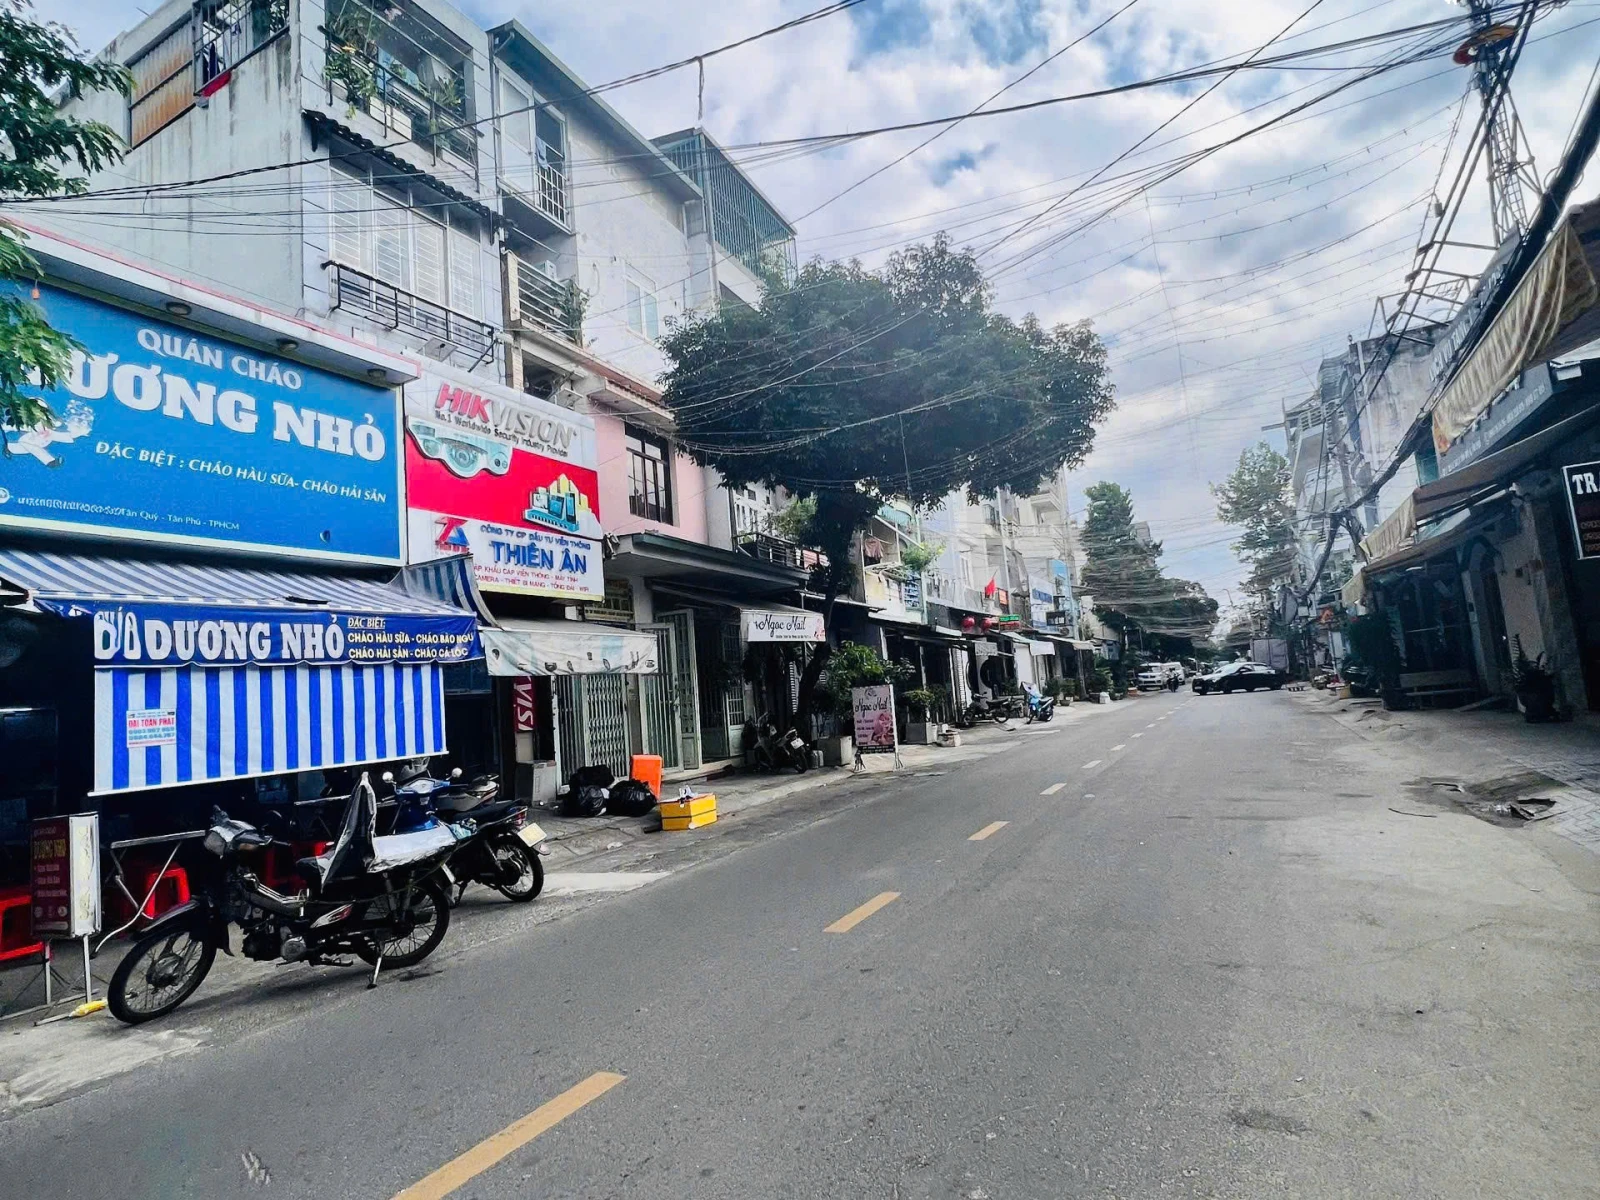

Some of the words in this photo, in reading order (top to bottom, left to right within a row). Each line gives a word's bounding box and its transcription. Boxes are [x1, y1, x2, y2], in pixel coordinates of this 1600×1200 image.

[137, 328, 223, 371] QUÁN
[231, 355, 302, 391] CHÁO
[21, 349, 259, 434] ƯƠNG
[273, 402, 386, 462] NHỎ
[434, 381, 574, 450] HIKVISION
[455, 414, 491, 434] Worldwide
[494, 428, 519, 446] Security
[521, 437, 545, 452] Industry
[547, 443, 569, 458] Provider
[95, 441, 134, 460] ĐẶC
[139, 450, 176, 468] BIỆT
[189, 458, 232, 478] CHÁO
[236, 465, 267, 483] HÀU
[302, 478, 337, 496] CHÁO
[340, 483, 362, 499] HẢI
[364, 486, 387, 504] SẢN
[1572, 472, 1600, 495] TR
[489, 540, 554, 571] THIÊN
[559, 547, 587, 574] ÂN
[144, 617, 271, 660] DƯƠNG
[280, 613, 345, 660] NHỎ
[347, 617, 365, 629] ĐẶC
[347, 631, 374, 643] CHÁO
[375, 631, 393, 644] HÀU
[394, 631, 411, 644] SỮA
[415, 631, 439, 644] CHÁO
[348, 647, 375, 659] CHÁO
[414, 646, 438, 658] CHÁO
[439, 646, 450, 658] CÁ
